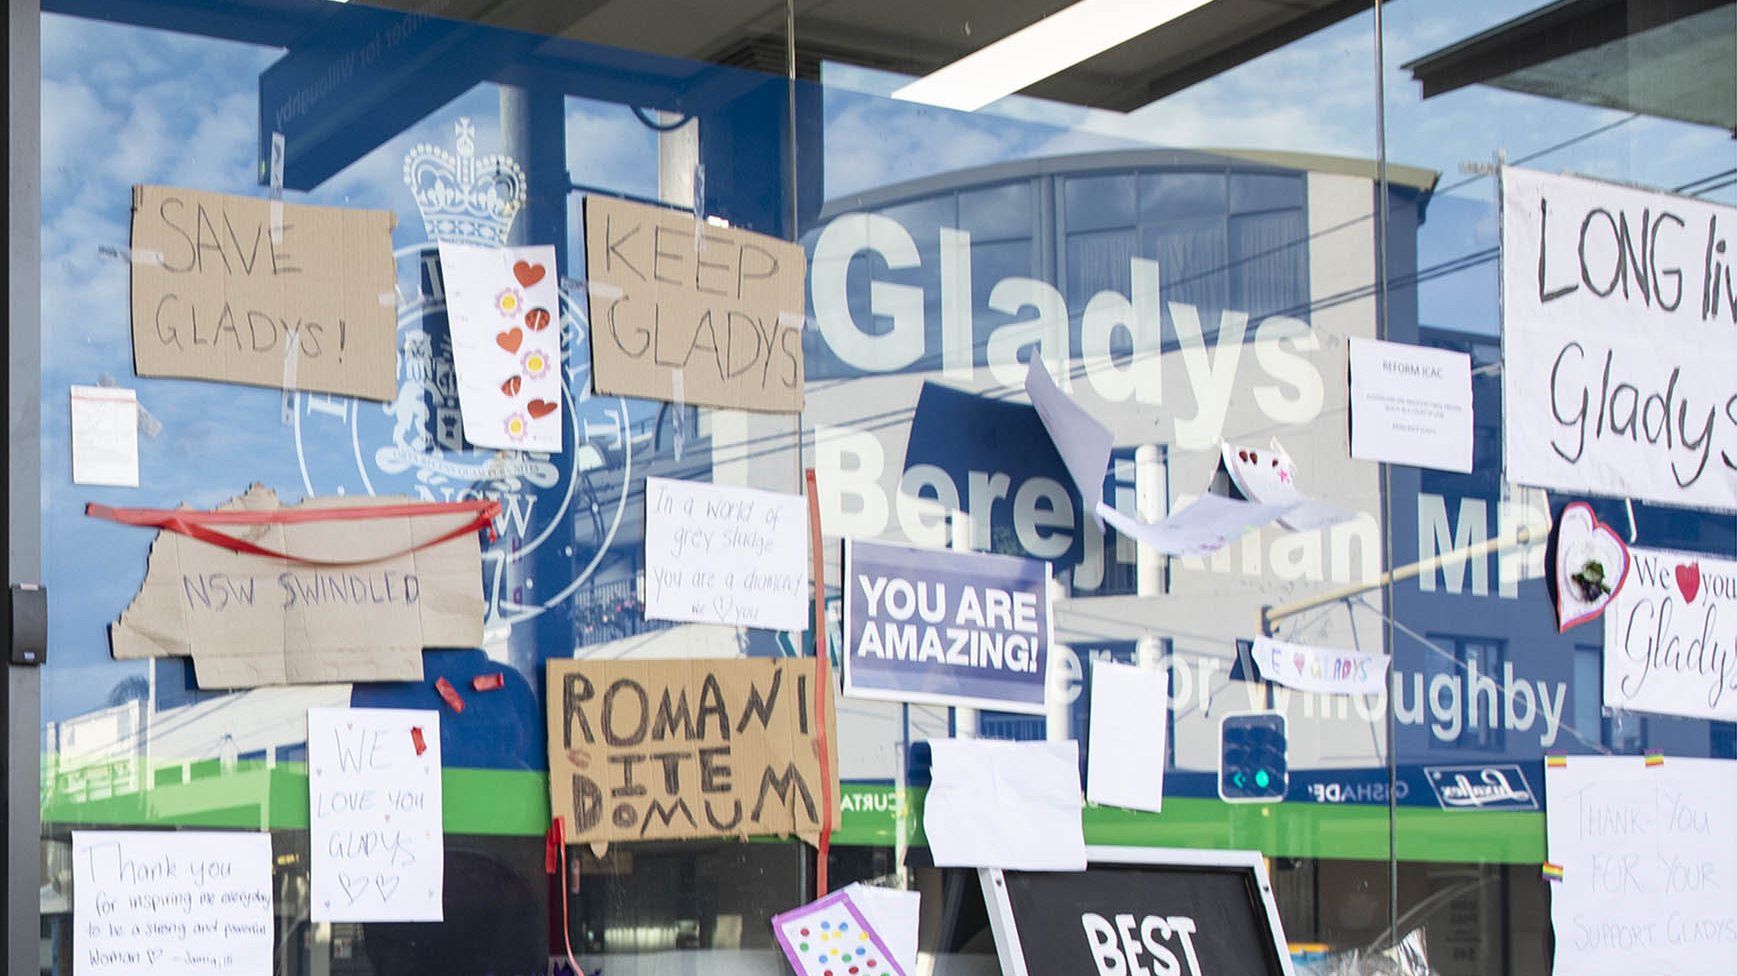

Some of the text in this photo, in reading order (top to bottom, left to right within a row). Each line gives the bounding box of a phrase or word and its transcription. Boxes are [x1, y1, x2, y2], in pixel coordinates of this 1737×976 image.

[159, 198, 302, 276] SAVE
[605, 214, 780, 299] KEEP
[1537, 198, 1685, 312] LONG
[156, 295, 347, 364] GLADYS!
[608, 295, 802, 391] GLADYS
[810, 211, 1324, 449] Gladys
[683, 497, 695, 516] a
[765, 505, 783, 531] of
[670, 526, 712, 558] grey
[182, 573, 256, 611] NSW
[692, 571, 716, 590] are
[725, 572, 734, 591] a
[858, 574, 1038, 634] YOU ARE
[1634, 555, 1737, 608] We you
[857, 623, 1038, 674] AMAZING!
[563, 668, 808, 749] ROMANI
[335, 726, 392, 774] WE
[608, 747, 732, 797] ITE
[317, 789, 376, 821] LOVE
[82, 841, 231, 887] Thank you
[328, 830, 416, 868] GLADYS
[1592, 851, 1643, 896] FOR
[95, 891, 116, 916] for
[129, 891, 192, 914] inspiring
[88, 922, 101, 939] to
[131, 923, 140, 936] a
[145, 922, 187, 940] strong
[193, 919, 218, 936] and
